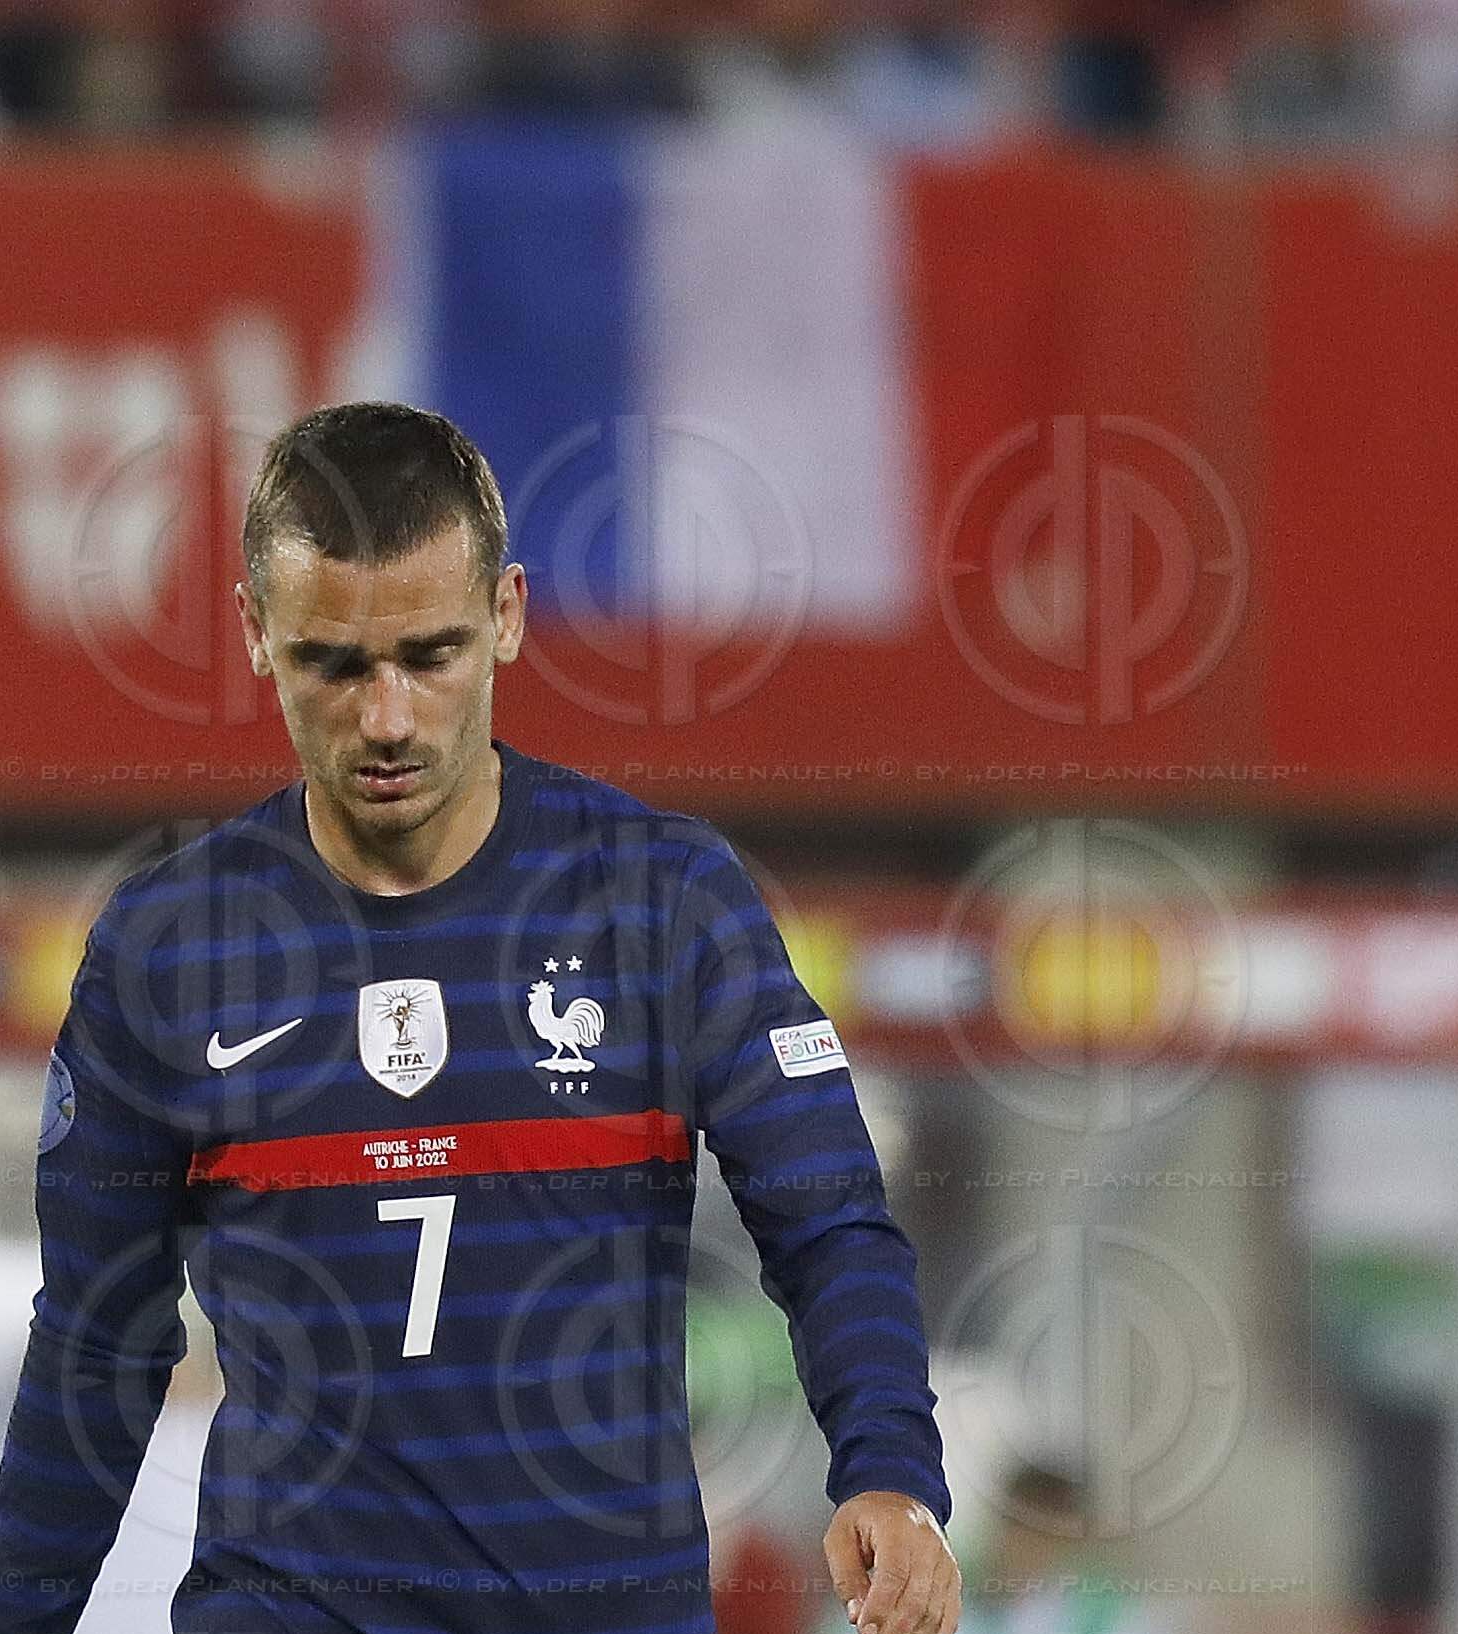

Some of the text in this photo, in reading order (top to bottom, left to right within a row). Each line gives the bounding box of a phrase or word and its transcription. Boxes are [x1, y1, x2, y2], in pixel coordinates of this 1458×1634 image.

[774, 1031, 801, 1043] UEFA
[388, 1053, 423, 1067] FIFA
[363, 1140, 409, 1156] AUTRICHE
[418, 1135, 457, 1152] FRANCE
[374, 1151, 448, 1170] 10 JUIN 2022
[377, 1194, 456, 1358] 7
